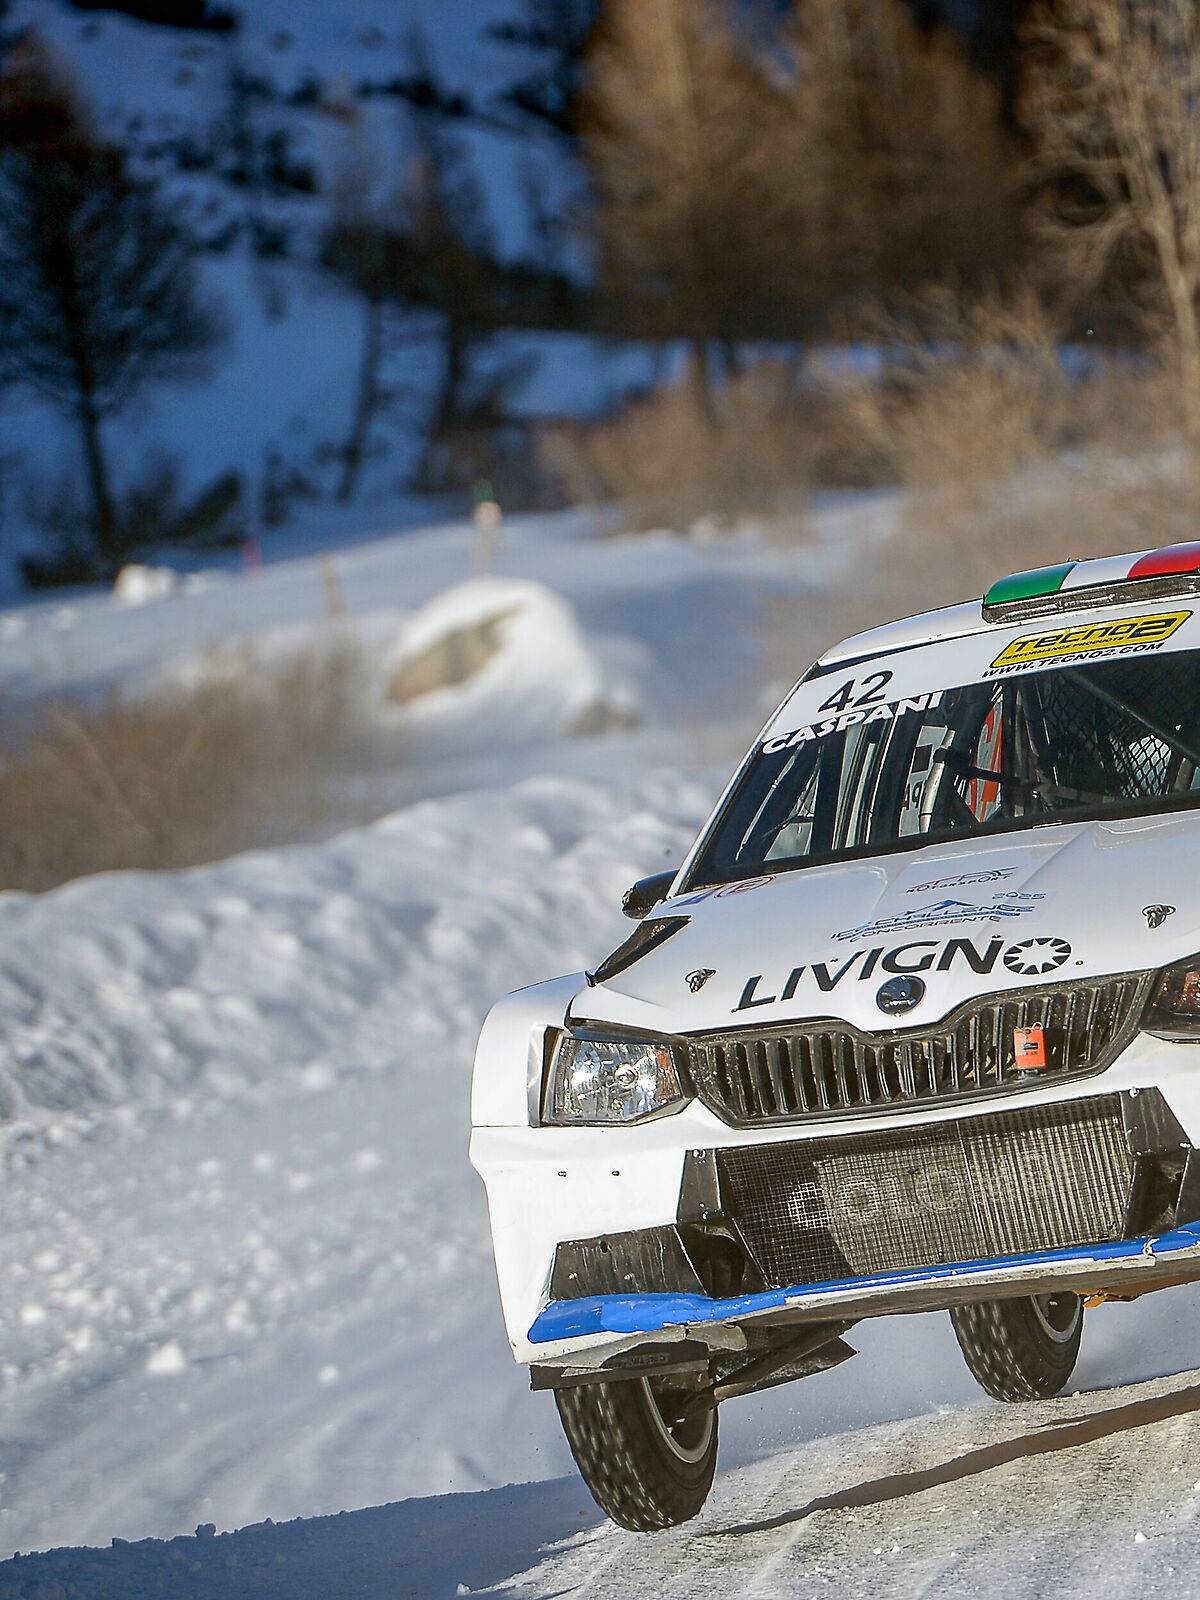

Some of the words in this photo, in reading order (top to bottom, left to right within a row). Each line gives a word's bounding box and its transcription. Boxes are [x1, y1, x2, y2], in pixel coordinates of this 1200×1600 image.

[817, 669, 895, 713] 42
[761, 690, 944, 755] CASPANI
[991, 891, 1047, 901] 2025
[848, 914, 1003, 943] CONCORRENTE
[732, 937, 1073, 1013] LIVIGNO
